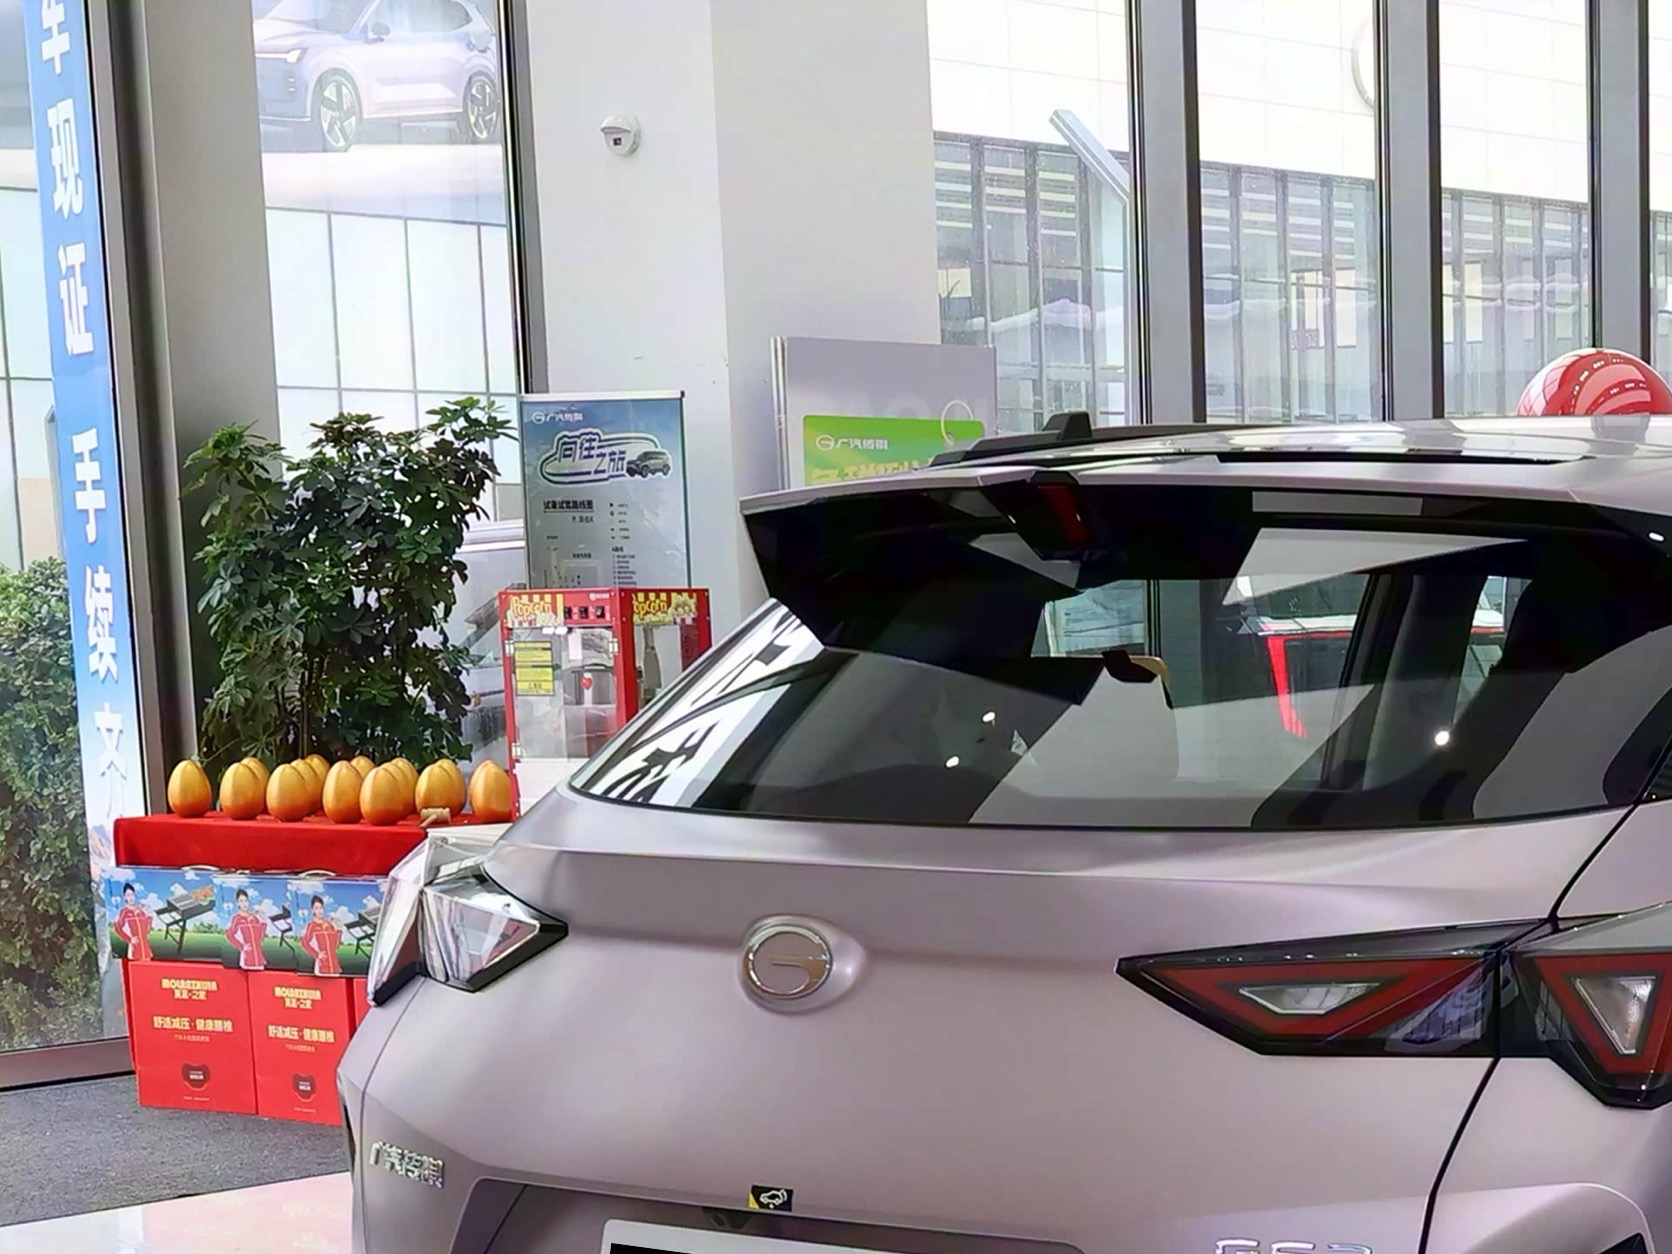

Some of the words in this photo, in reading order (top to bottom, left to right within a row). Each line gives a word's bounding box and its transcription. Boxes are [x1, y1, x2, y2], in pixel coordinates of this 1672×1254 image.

[836, 437, 889, 450] 广汽传祺
[369, 1140, 444, 1189] 广汽传祺
